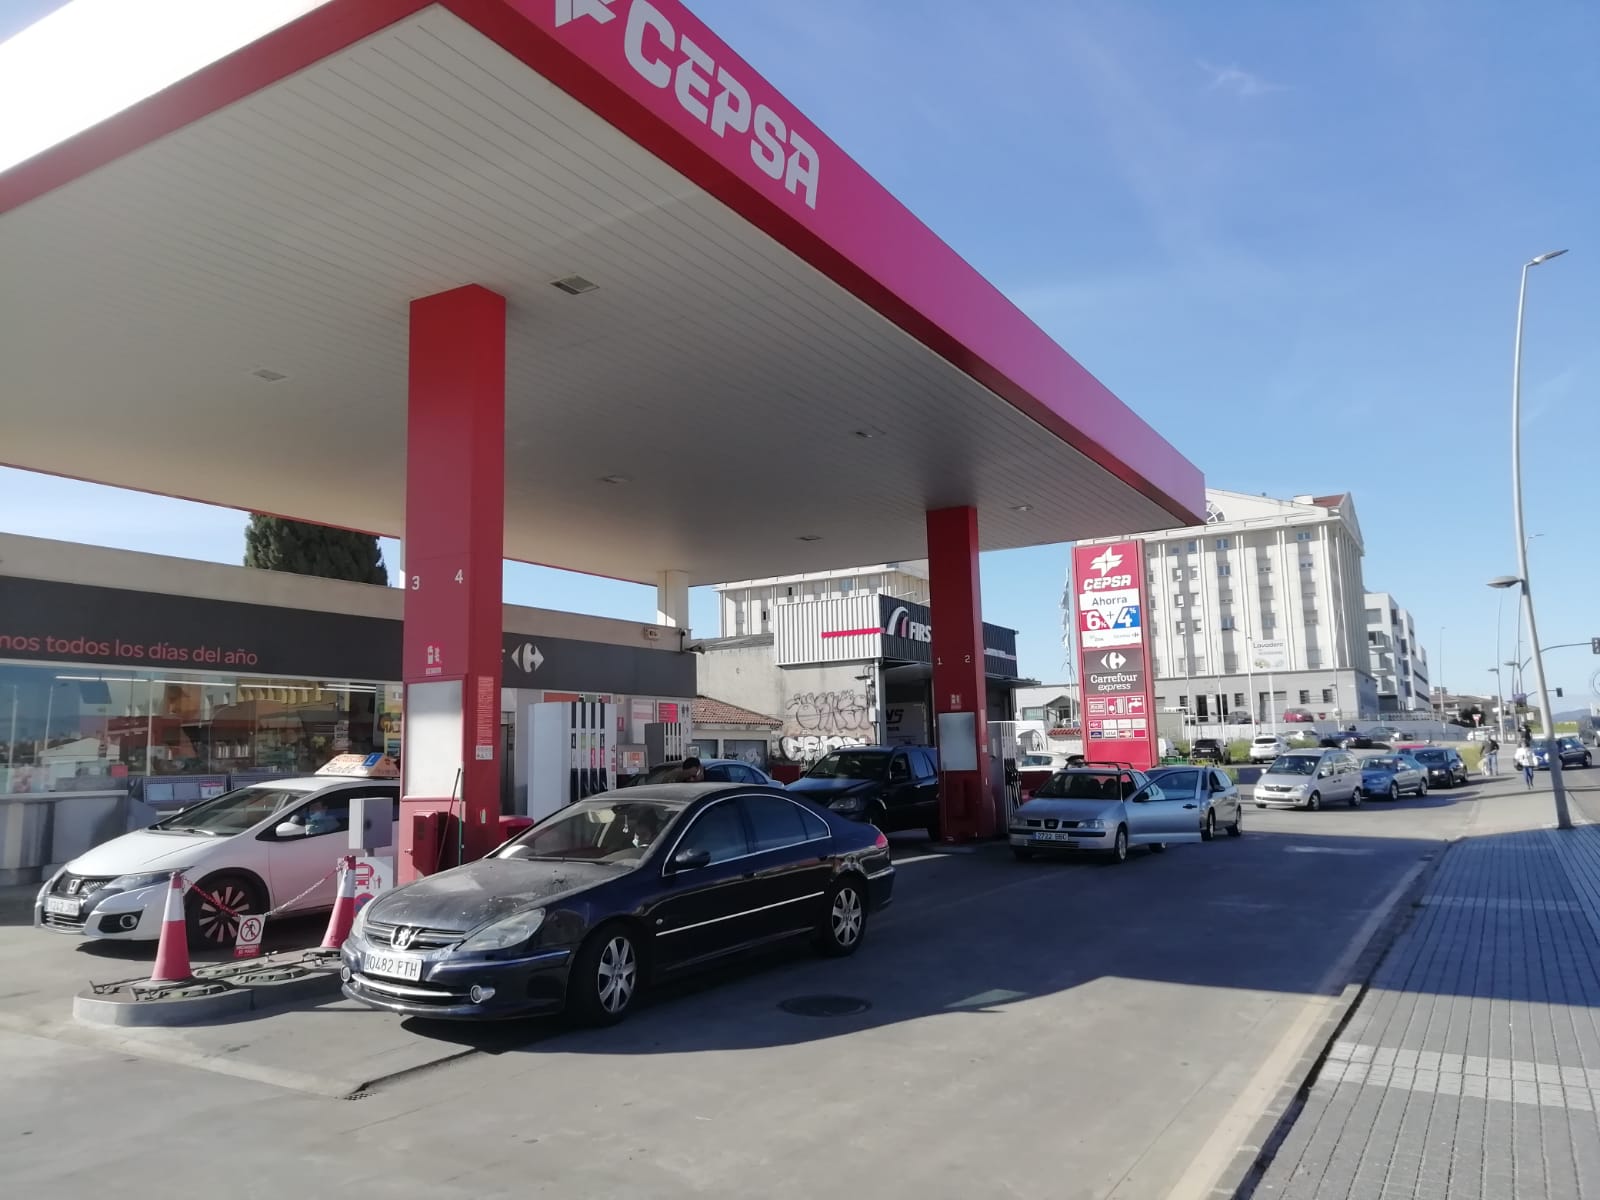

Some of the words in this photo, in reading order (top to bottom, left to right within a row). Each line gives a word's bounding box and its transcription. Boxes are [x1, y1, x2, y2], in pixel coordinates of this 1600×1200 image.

[624, 0, 820, 210] CEPSA
[412, 576, 420, 590] 3
[455, 569, 464, 584] 4
[1083, 575, 1132, 591] CEPSA
[1092, 596, 1128, 606] Ahorra
[46, 636, 110, 656] todos
[115, 640, 144, 658] los
[148, 642, 189, 661] días
[192, 645, 220, 663] del
[224, 648, 258, 665] año
[937, 657, 943, 665] 1
[964, 655, 970, 663] 2
[1090, 673, 1138, 683] Carrefour
[1098, 683, 1131, 692] express
[370, 955, 394, 973] 0482
[396, 960, 418, 977] FTH
